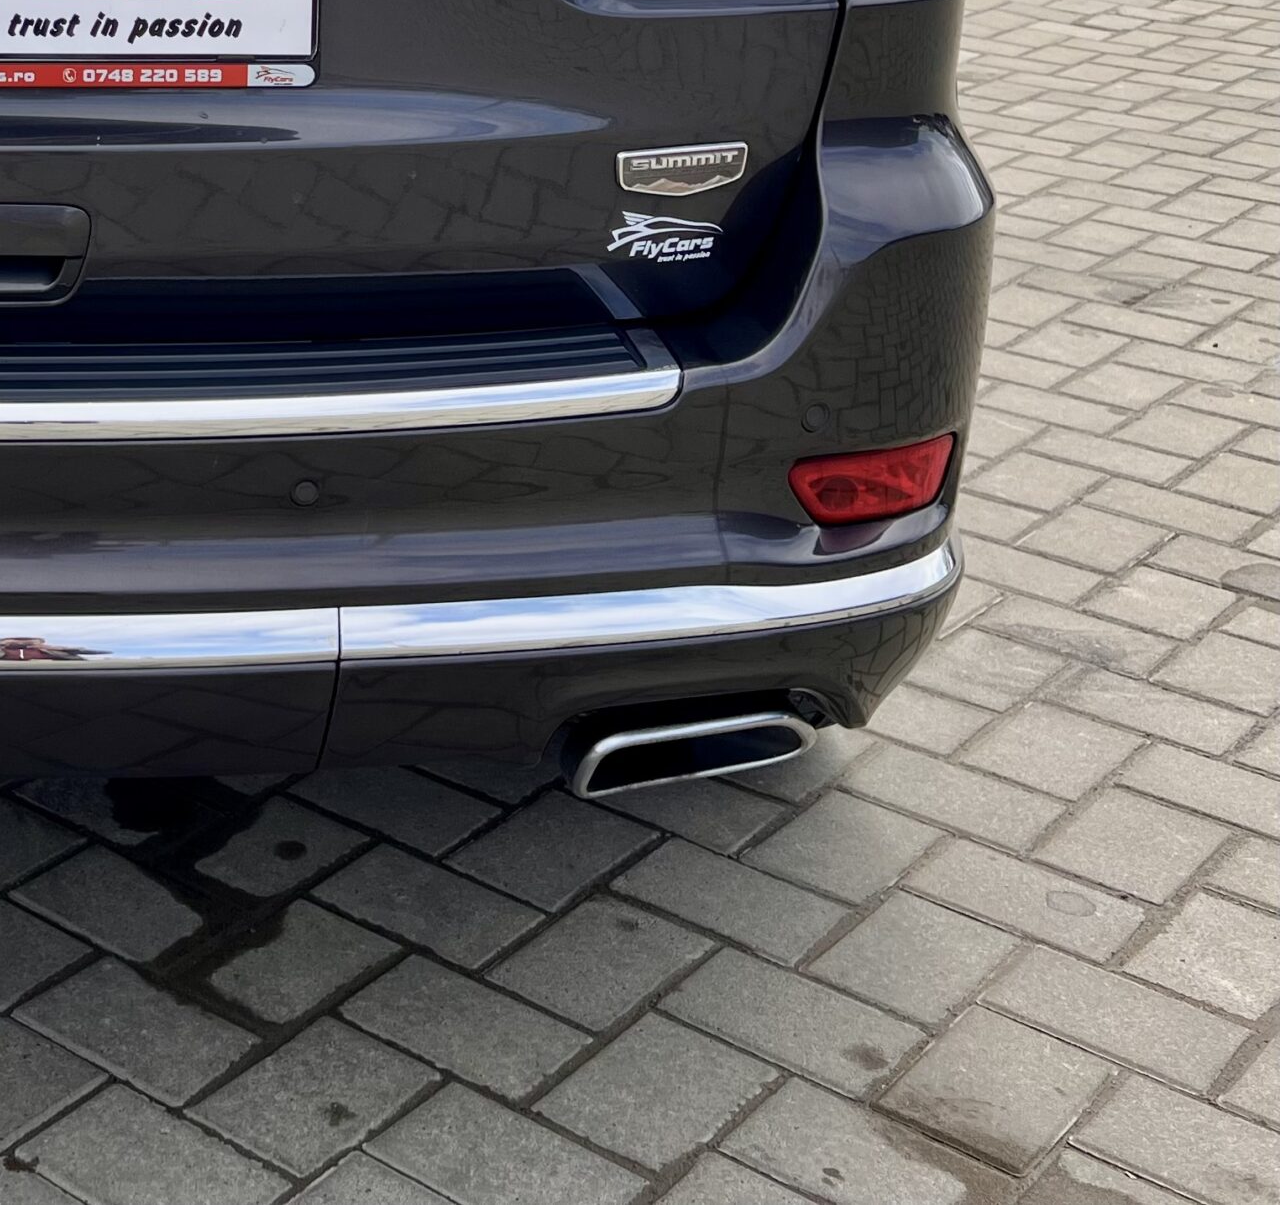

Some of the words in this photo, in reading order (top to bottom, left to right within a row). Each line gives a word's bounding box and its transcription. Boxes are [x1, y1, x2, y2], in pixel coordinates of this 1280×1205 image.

[7, 13, 82, 38] trust
[89, 12, 120, 38] in
[127, 12, 244, 44] passion
[83, 69, 134, 82] 0748
[140, 69, 178, 82] 220
[184, 69, 222, 82] 589
[630, 151, 739, 172] SUMMIT
[629, 237, 714, 259] FlyCars
